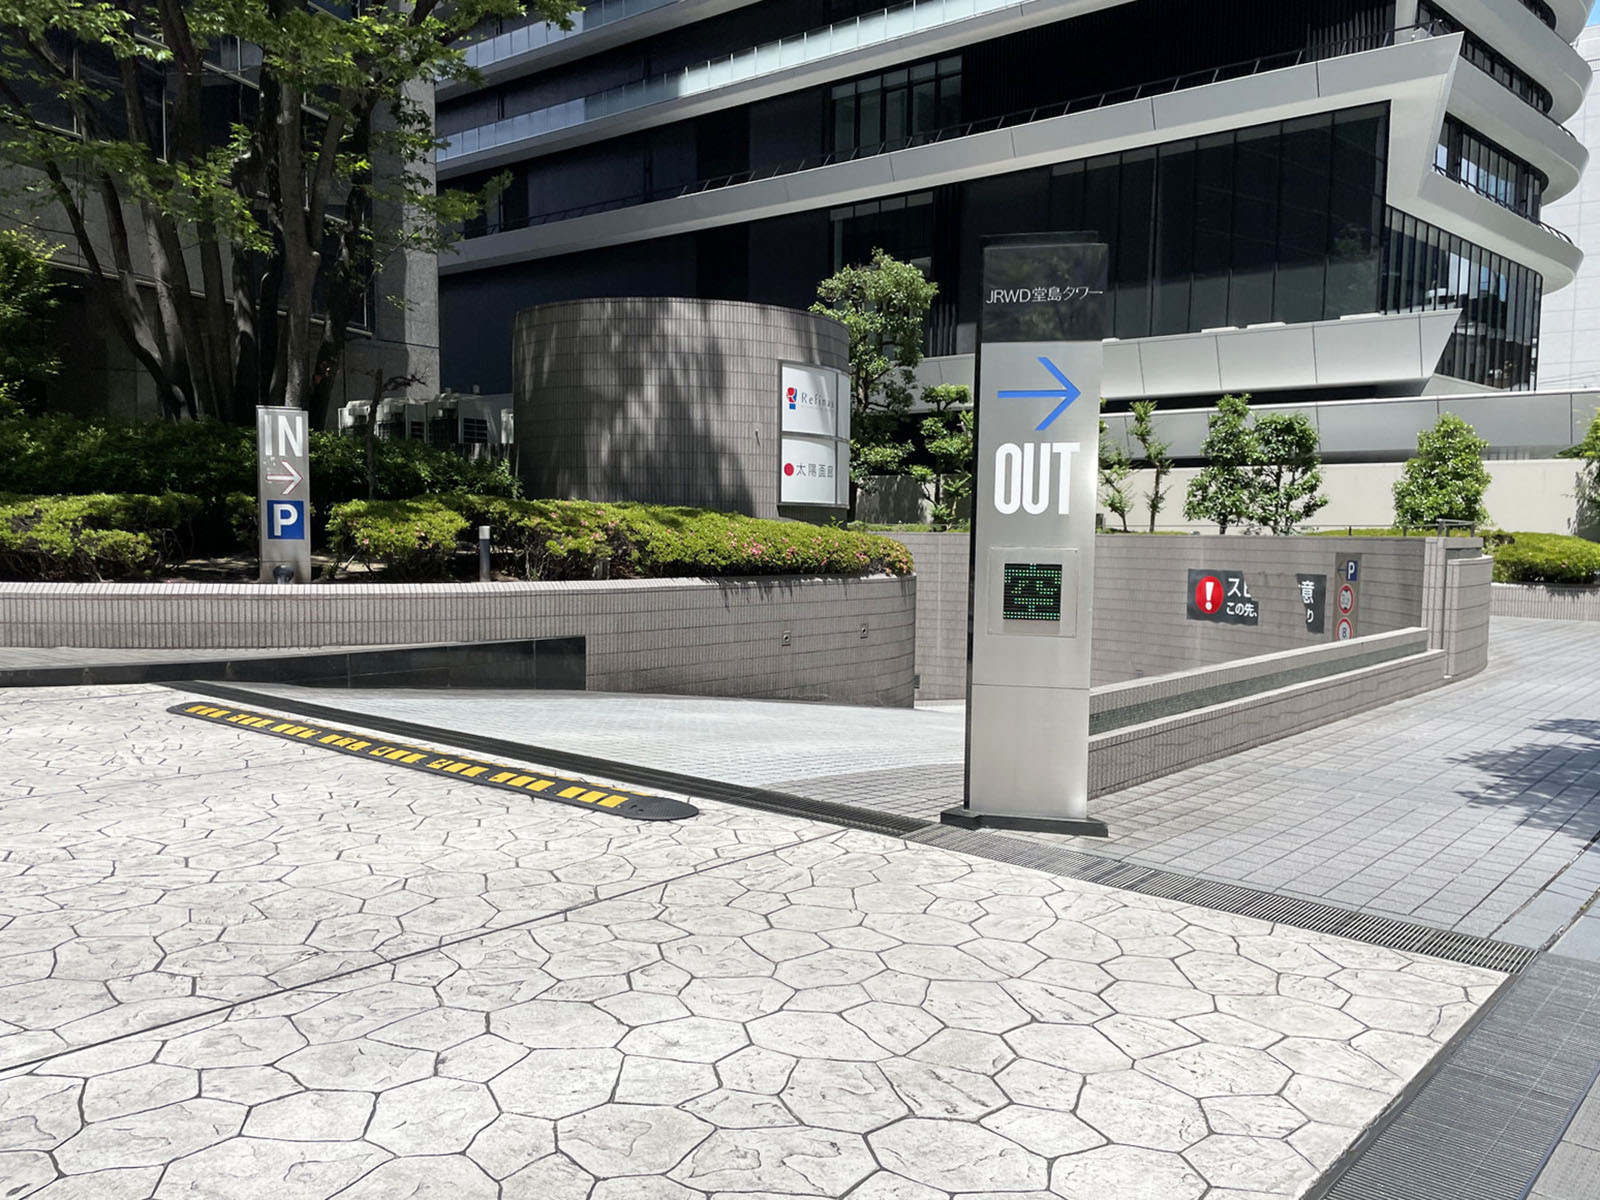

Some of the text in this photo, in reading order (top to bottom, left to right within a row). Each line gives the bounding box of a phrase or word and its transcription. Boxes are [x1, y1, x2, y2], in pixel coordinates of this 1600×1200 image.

[986, 286, 1104, 303] JRWD堂島タワー
[264, 415, 303, 457] IN
[994, 442, 1081, 515] OUT
[273, 503, 298, 536] P
[1347, 561, 1355, 580] P
[1003, 563, 1061, 620] 空
